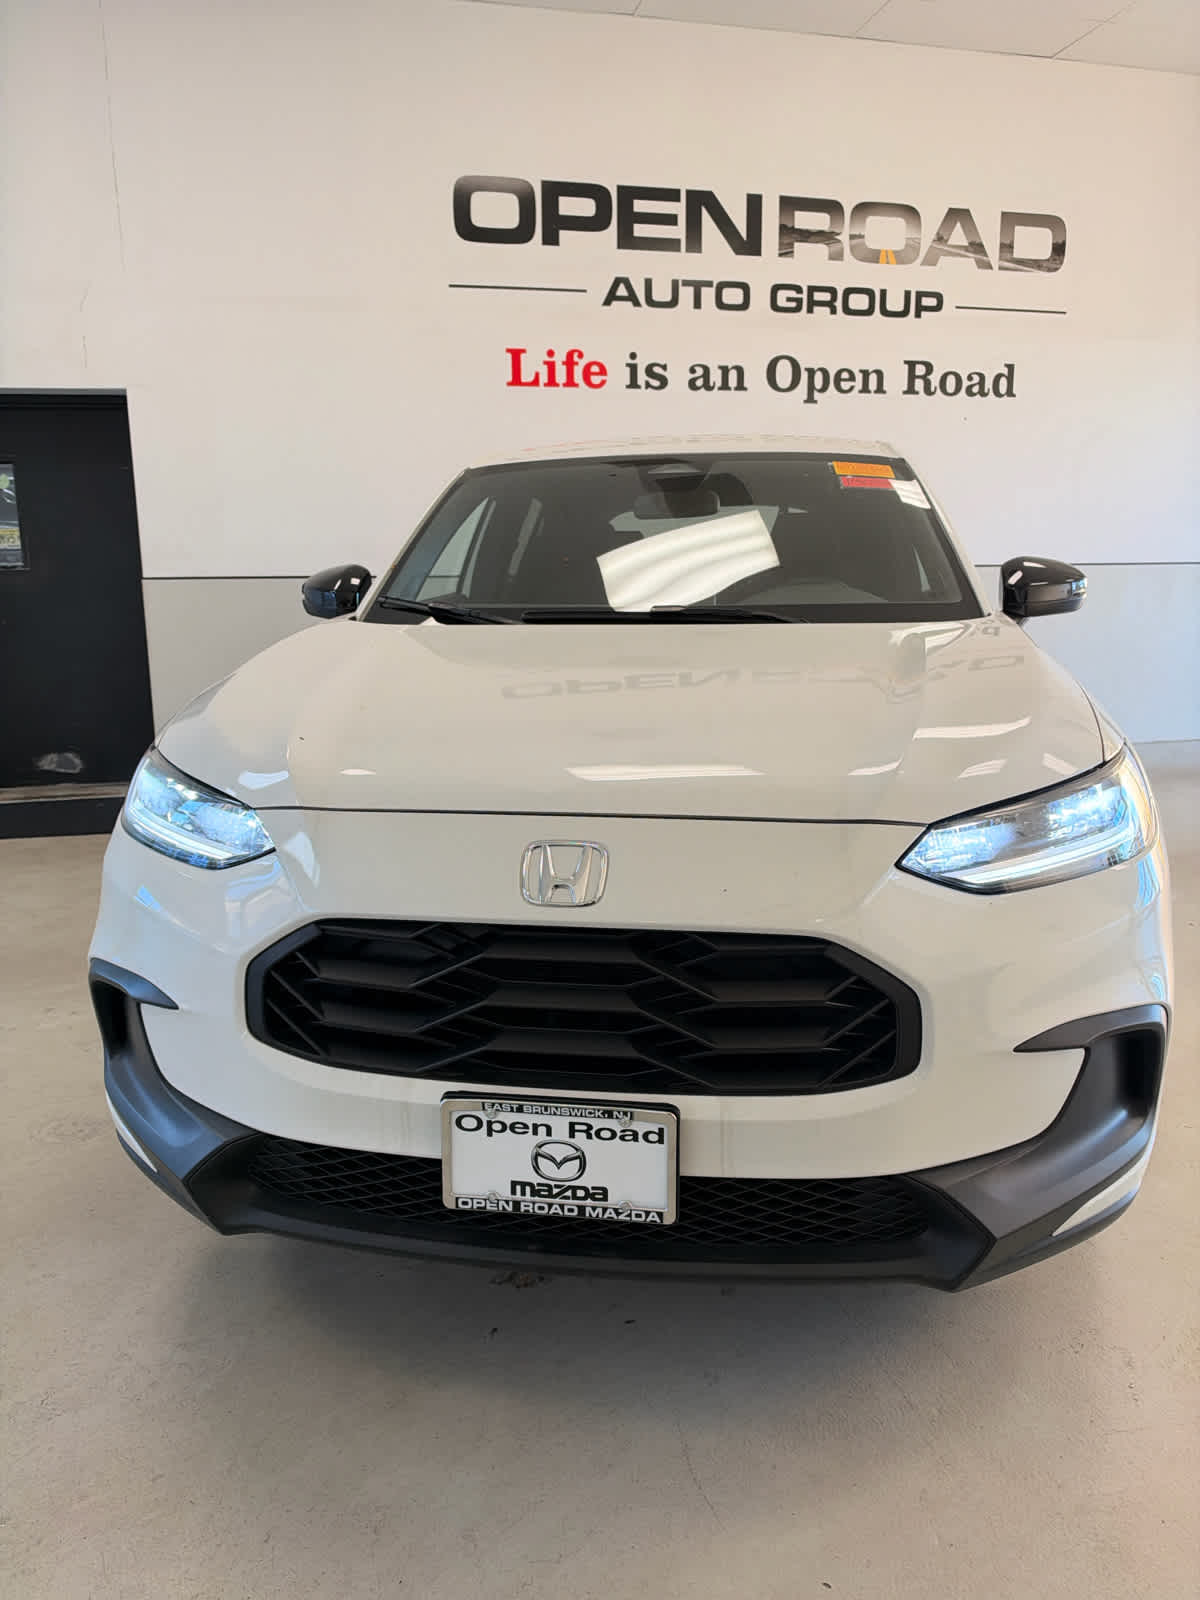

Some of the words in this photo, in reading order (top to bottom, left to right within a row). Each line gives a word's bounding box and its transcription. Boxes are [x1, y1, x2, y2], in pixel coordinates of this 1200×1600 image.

[453, 175, 763, 256] OPEN
[778, 195, 1067, 272] ROAD
[602, 277, 751, 312] AUTO
[769, 283, 944, 319] GROUP
[505, 348, 608, 389] Life
[625, 352, 669, 391] is
[687, 363, 748, 391] an
[765, 355, 887, 404] Open
[902, 360, 1017, 398] Road
[484, 1103, 519, 1112] EAST
[455, 1114, 552, 1137] Open
[568, 1121, 664, 1145] Road
[458, 1198, 513, 1212] OPEN
[520, 1203, 578, 1216] ROAD
[585, 1208, 661, 1223] MAZDA
